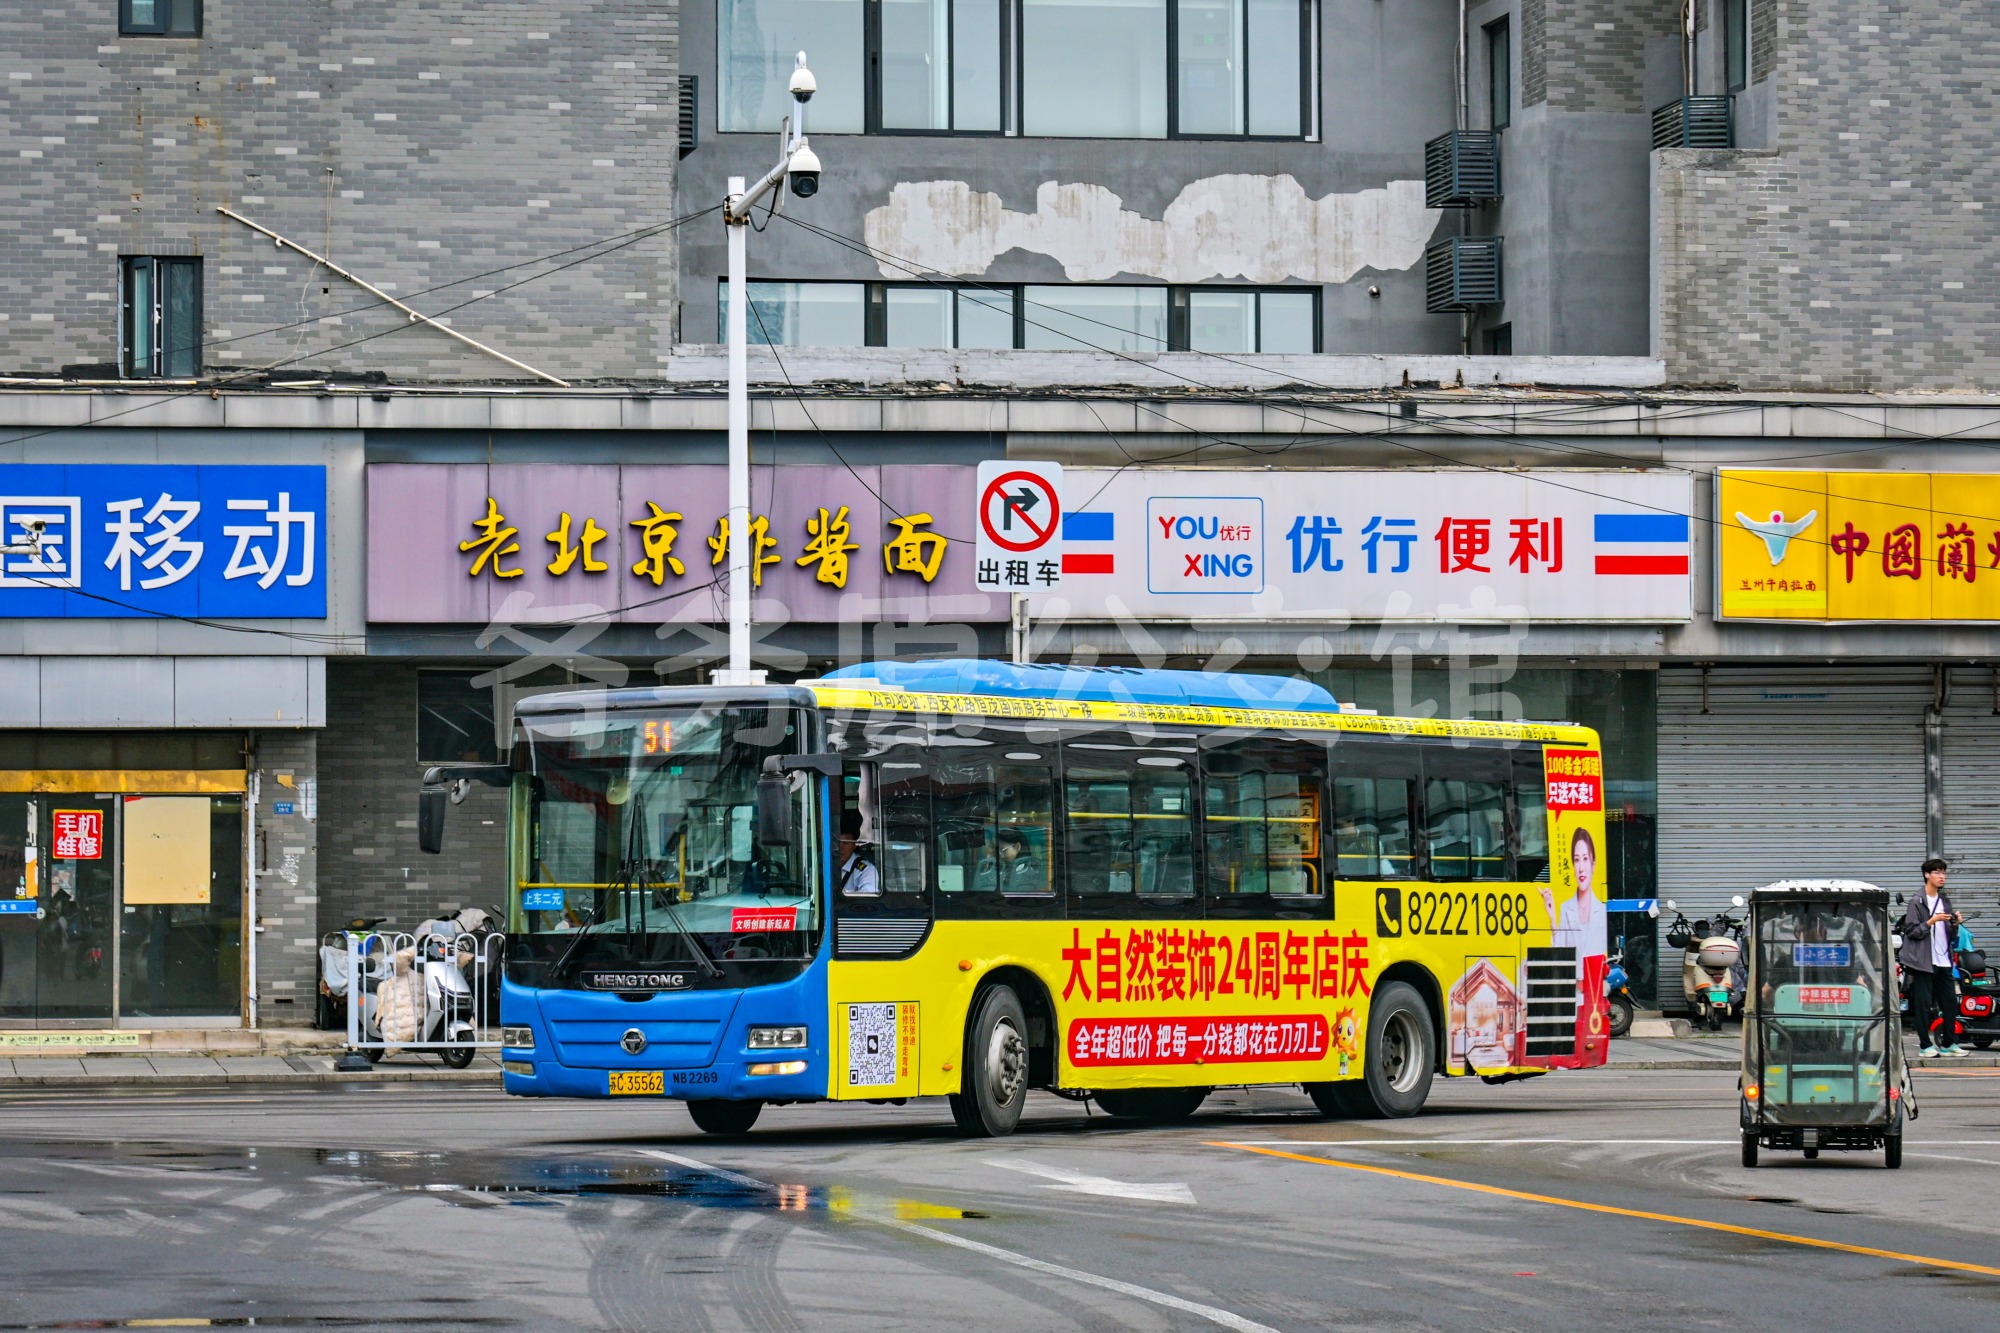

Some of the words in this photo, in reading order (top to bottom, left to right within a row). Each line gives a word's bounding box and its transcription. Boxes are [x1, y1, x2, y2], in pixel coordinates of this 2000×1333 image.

[1158, 516, 1219, 540] YOU
[1219, 525, 1252, 541] 优行
[0, 491, 316, 591] 国移动
[1285, 515, 1563, 574] 优行便利
[978, 558, 1060, 587] 出租车
[1184, 553, 1253, 577] XING
[1739, 578, 1816, 591] 兰州牛肉拉面
[645, 721, 672, 753] 51
[1547, 756, 1600, 776] 100条金项链
[57, 814, 99, 834] 手机
[56, 835, 99, 856] 维修
[524, 892, 562, 906] 上车二元
[735, 918, 791, 930] 文明创建新起点
[1408, 891, 1529, 936] 82221888
[1061, 927, 1371, 1004] 大自然装饰24周年店庆
[593, 974, 684, 988] HENGTONG
[1074, 1025, 1152, 1060] 全年超低价
[1155, 1021, 1322, 1058] 把每一分钱都花在刀刃上
[673, 1071, 718, 1084] NB2269
